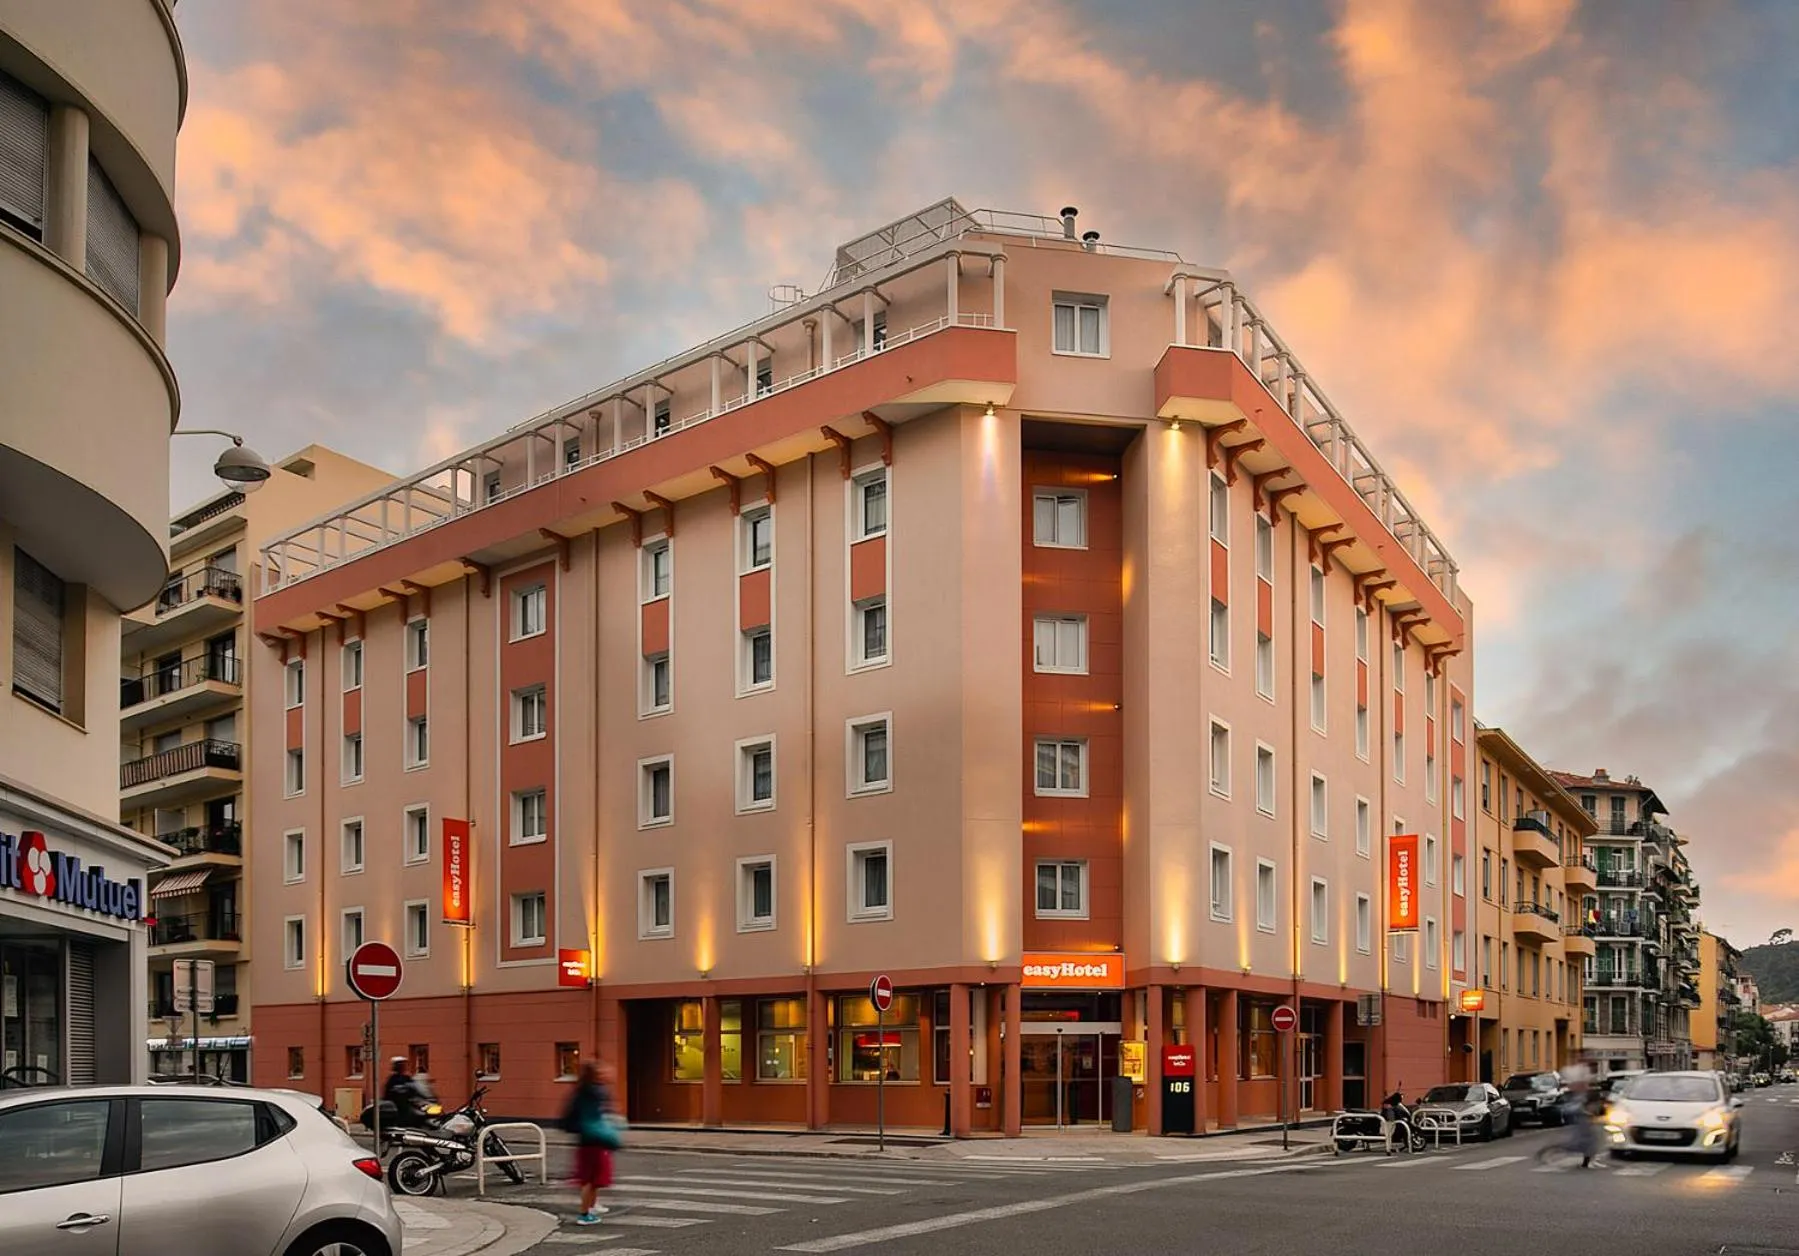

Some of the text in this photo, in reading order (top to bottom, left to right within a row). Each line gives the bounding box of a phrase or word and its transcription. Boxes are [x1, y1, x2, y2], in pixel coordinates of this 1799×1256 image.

[55, 851, 143, 920] Mutuel
[1397, 850, 1411, 917] easyHotel
[1023, 962, 1107, 979] easyHotel
[1170, 1081, 1190, 1093] 106
